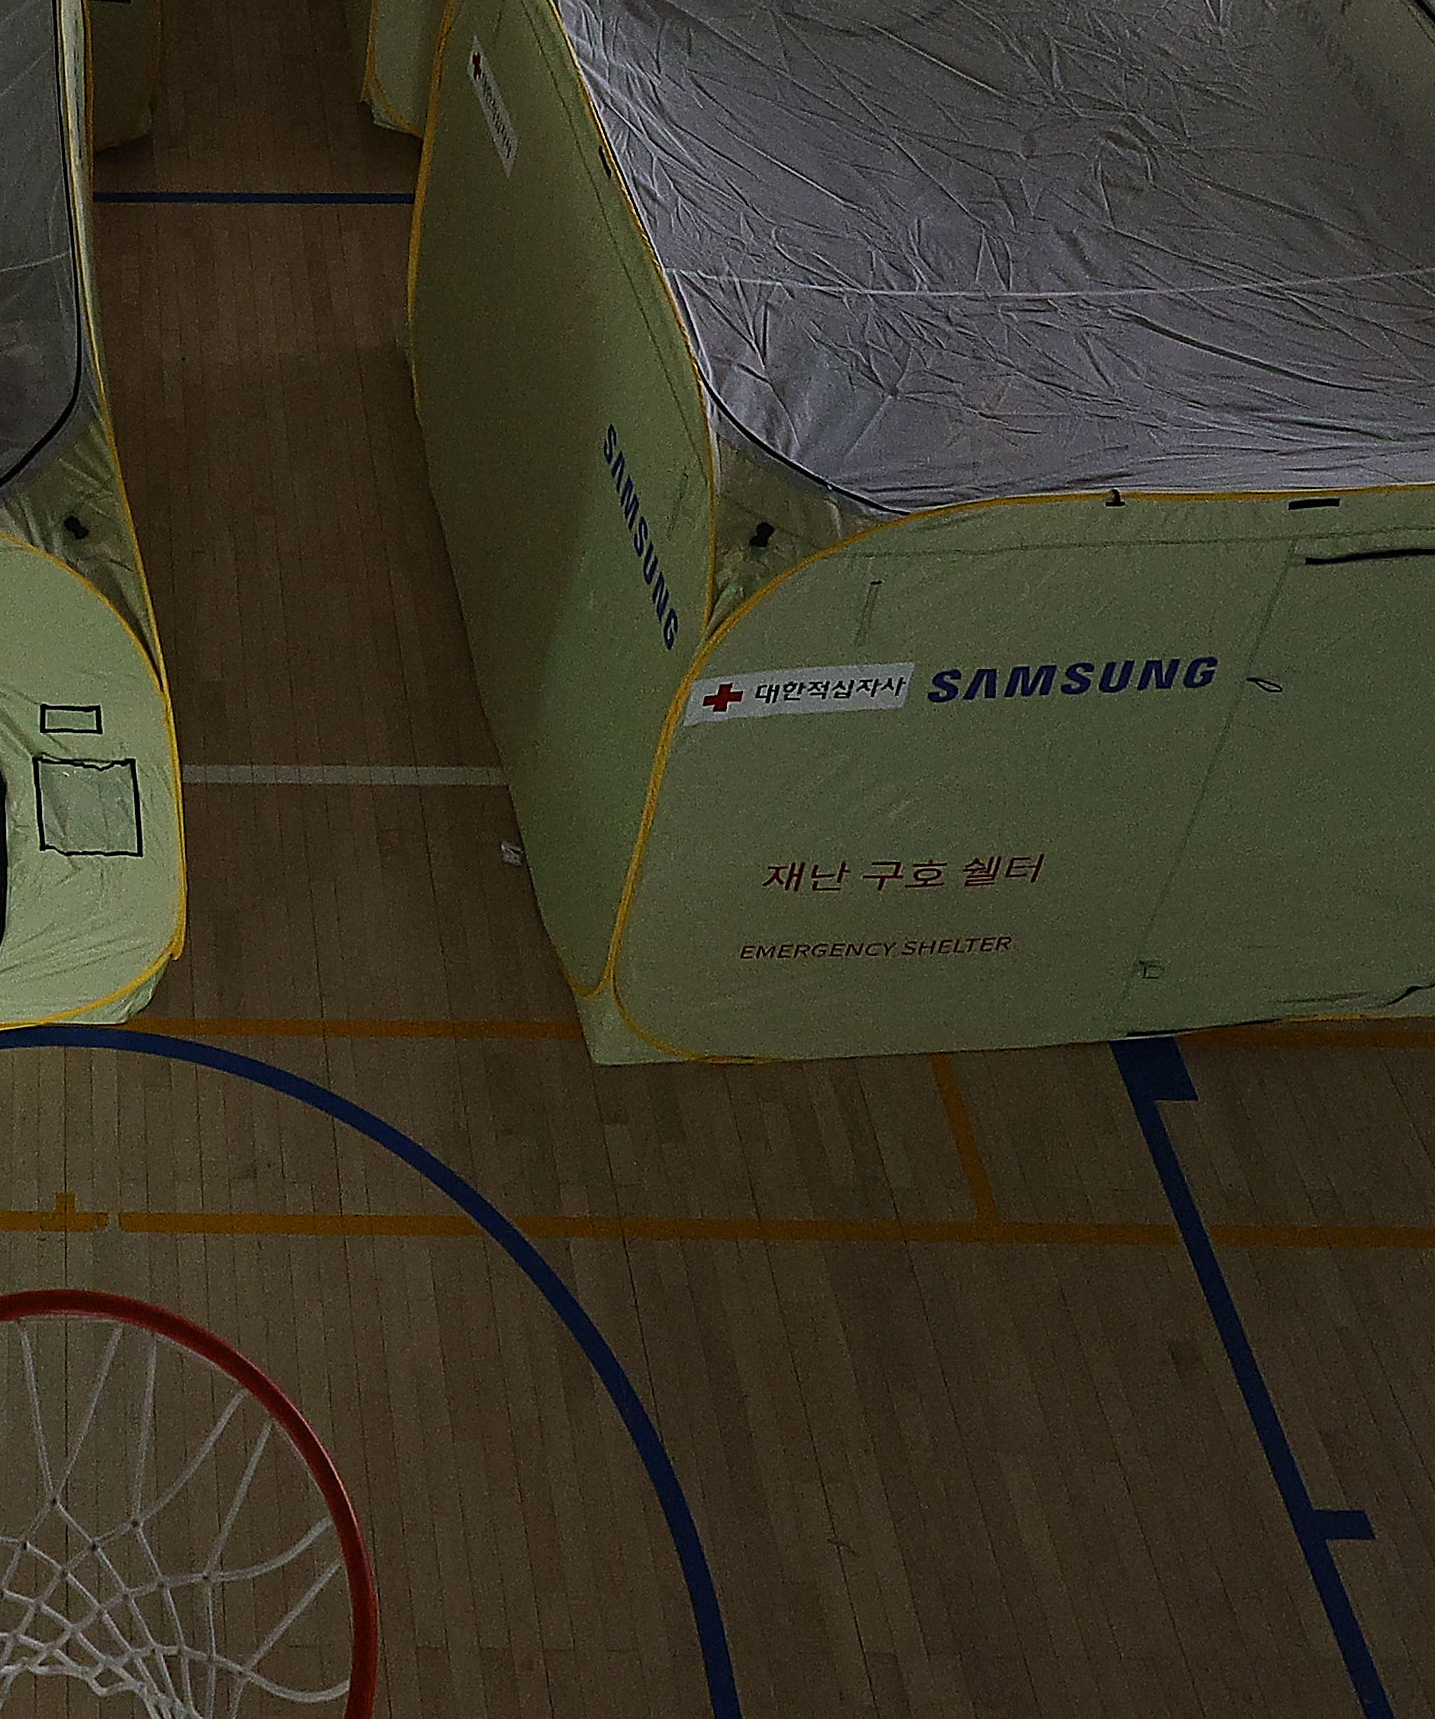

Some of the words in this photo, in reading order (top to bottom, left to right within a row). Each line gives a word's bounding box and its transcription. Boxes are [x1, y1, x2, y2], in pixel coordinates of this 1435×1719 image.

[602, 423, 677, 651] SAMSUNG
[754, 675, 907, 705] 대한적십자사
[926, 655, 1218, 706] SAMSUNG
[763, 861, 844, 893] 재난
[862, 860, 947, 890] 구호
[961, 853, 1045, 886] 쉘터
[738, 939, 896, 962] EMERGENCY
[900, 934, 1014, 957] SHELTER
